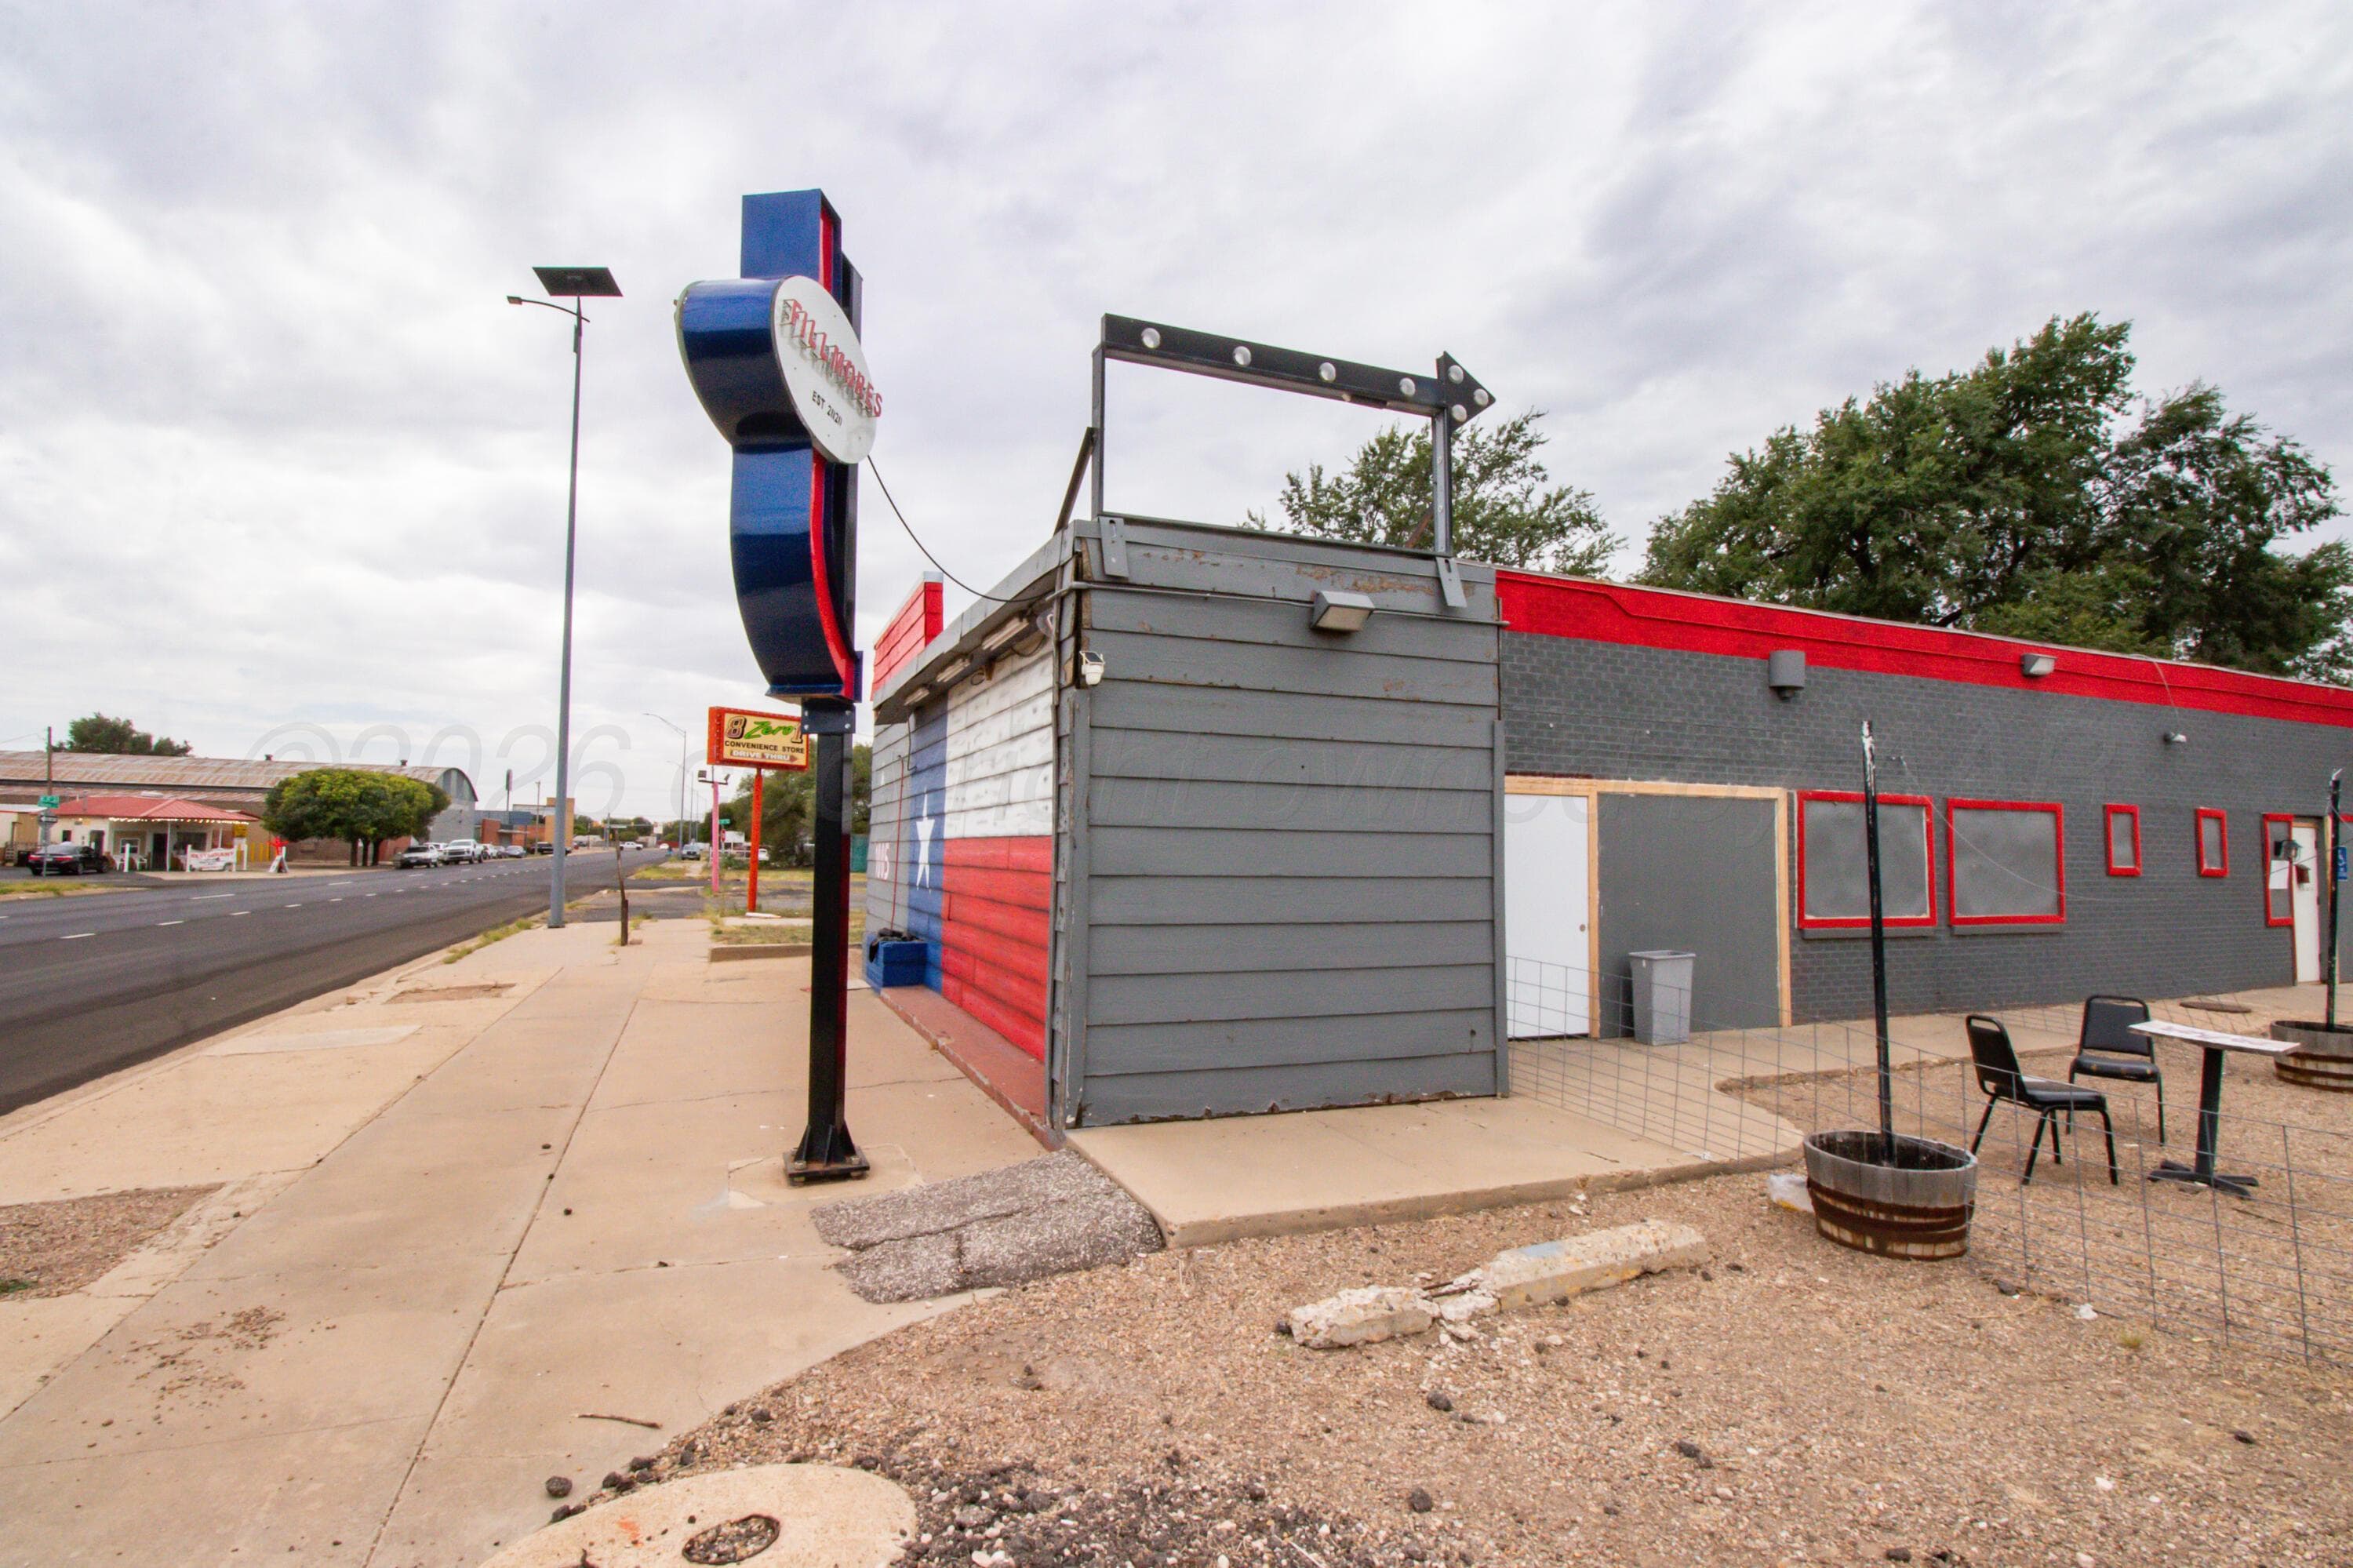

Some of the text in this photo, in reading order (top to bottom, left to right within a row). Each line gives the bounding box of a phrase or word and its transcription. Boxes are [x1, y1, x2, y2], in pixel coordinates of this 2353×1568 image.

[788, 299, 883, 417] FILLMORES
[812, 390, 843, 427] EST 2020
[726, 715, 747, 740] 8
[744, 721, 795, 739] Zero
[724, 740, 805, 754] CONVENIENCE STORE
[732, 750, 791, 761] DRIVE THRU
